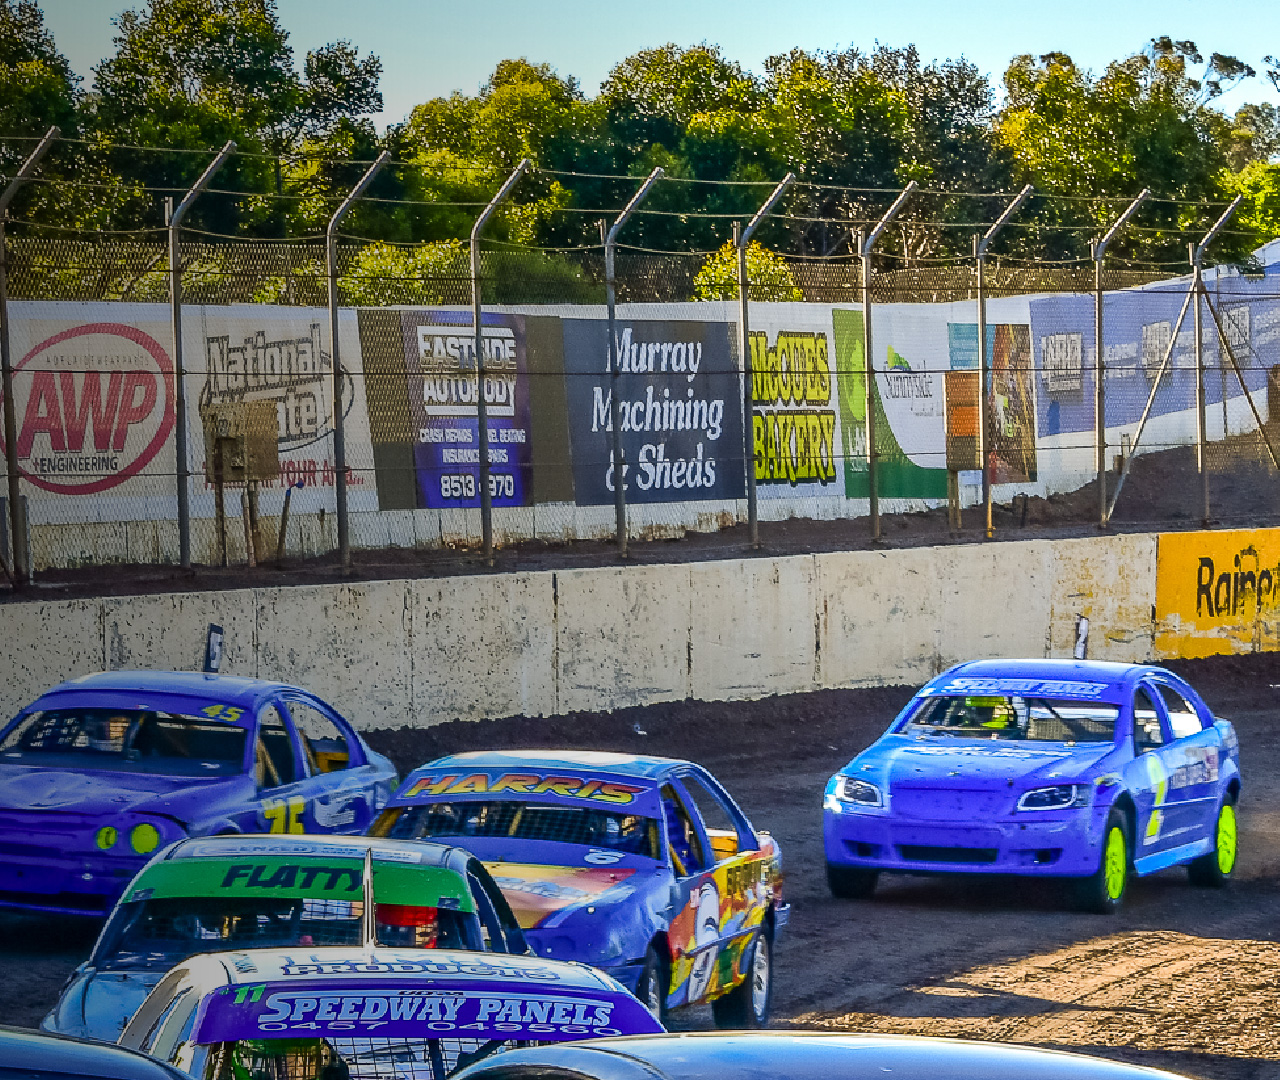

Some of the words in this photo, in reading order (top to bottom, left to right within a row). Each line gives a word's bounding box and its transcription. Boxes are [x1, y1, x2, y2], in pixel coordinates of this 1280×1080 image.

[206, 323, 322, 393] National
[421, 337, 516, 370] EASTIDE
[606, 328, 701, 382] Murray
[16, 370, 157, 459] AWP
[592, 386, 724, 440] Machining
[635, 442, 716, 490] Sheds
[752, 410, 836, 487] BAKERY
[440, 475, 475, 497] 8513
[402, 773, 650, 804] HARRIS
[221, 863, 377, 891] FLATTY
[258, 996, 467, 1023] SPEEDWAY
[475, 998, 613, 1027] PANELS
